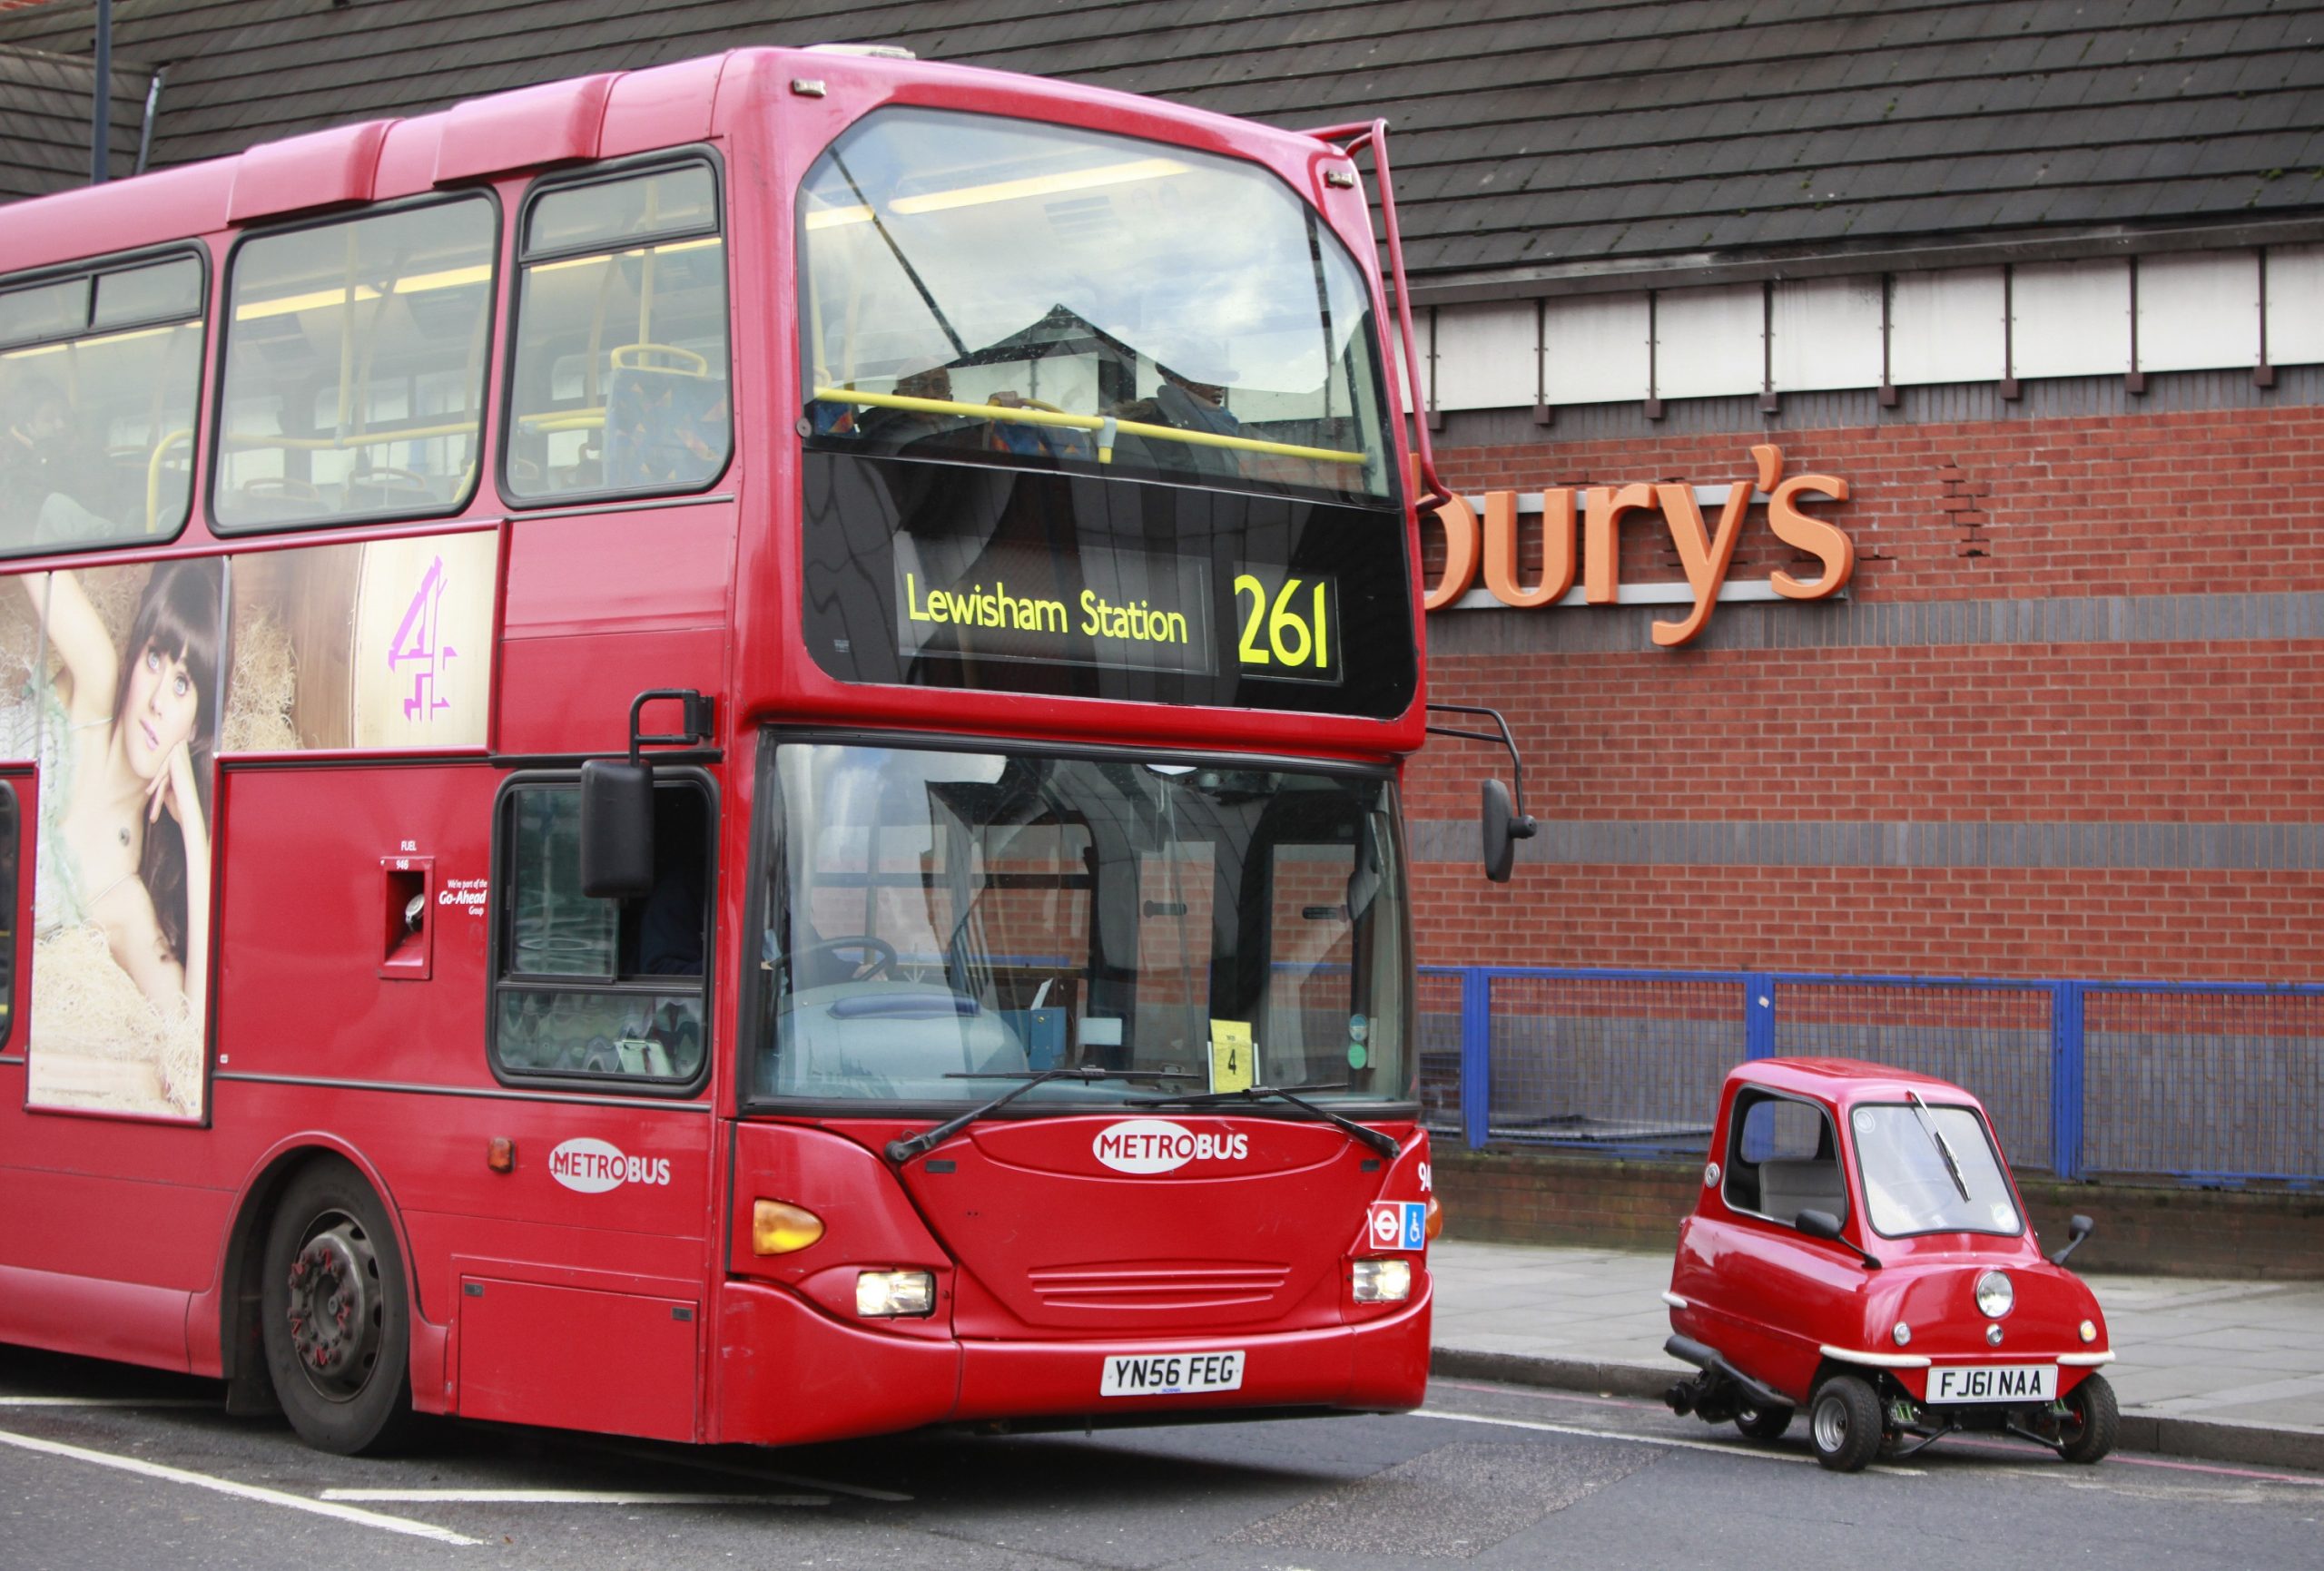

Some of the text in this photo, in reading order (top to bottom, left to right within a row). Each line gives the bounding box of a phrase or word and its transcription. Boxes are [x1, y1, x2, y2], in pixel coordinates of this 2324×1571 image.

[906, 573, 1187, 643] Lewisham Station
[1235, 574, 1328, 668] 261
[400, 840, 417, 851] FUEL
[438, 889, 487, 905] Go-Ahead
[461, 880, 473, 890] part
[473, 879, 480, 889] of
[468, 905, 484, 918] Group
[1227, 1048, 1236, 1075] 4
[1099, 1133, 1249, 1160] METROBUS
[554, 1151, 671, 1185] METROBUS
[1116, 1355, 1236, 1388] YN56 FEG
[1940, 1370, 2042, 1398] FJ61 NAA
